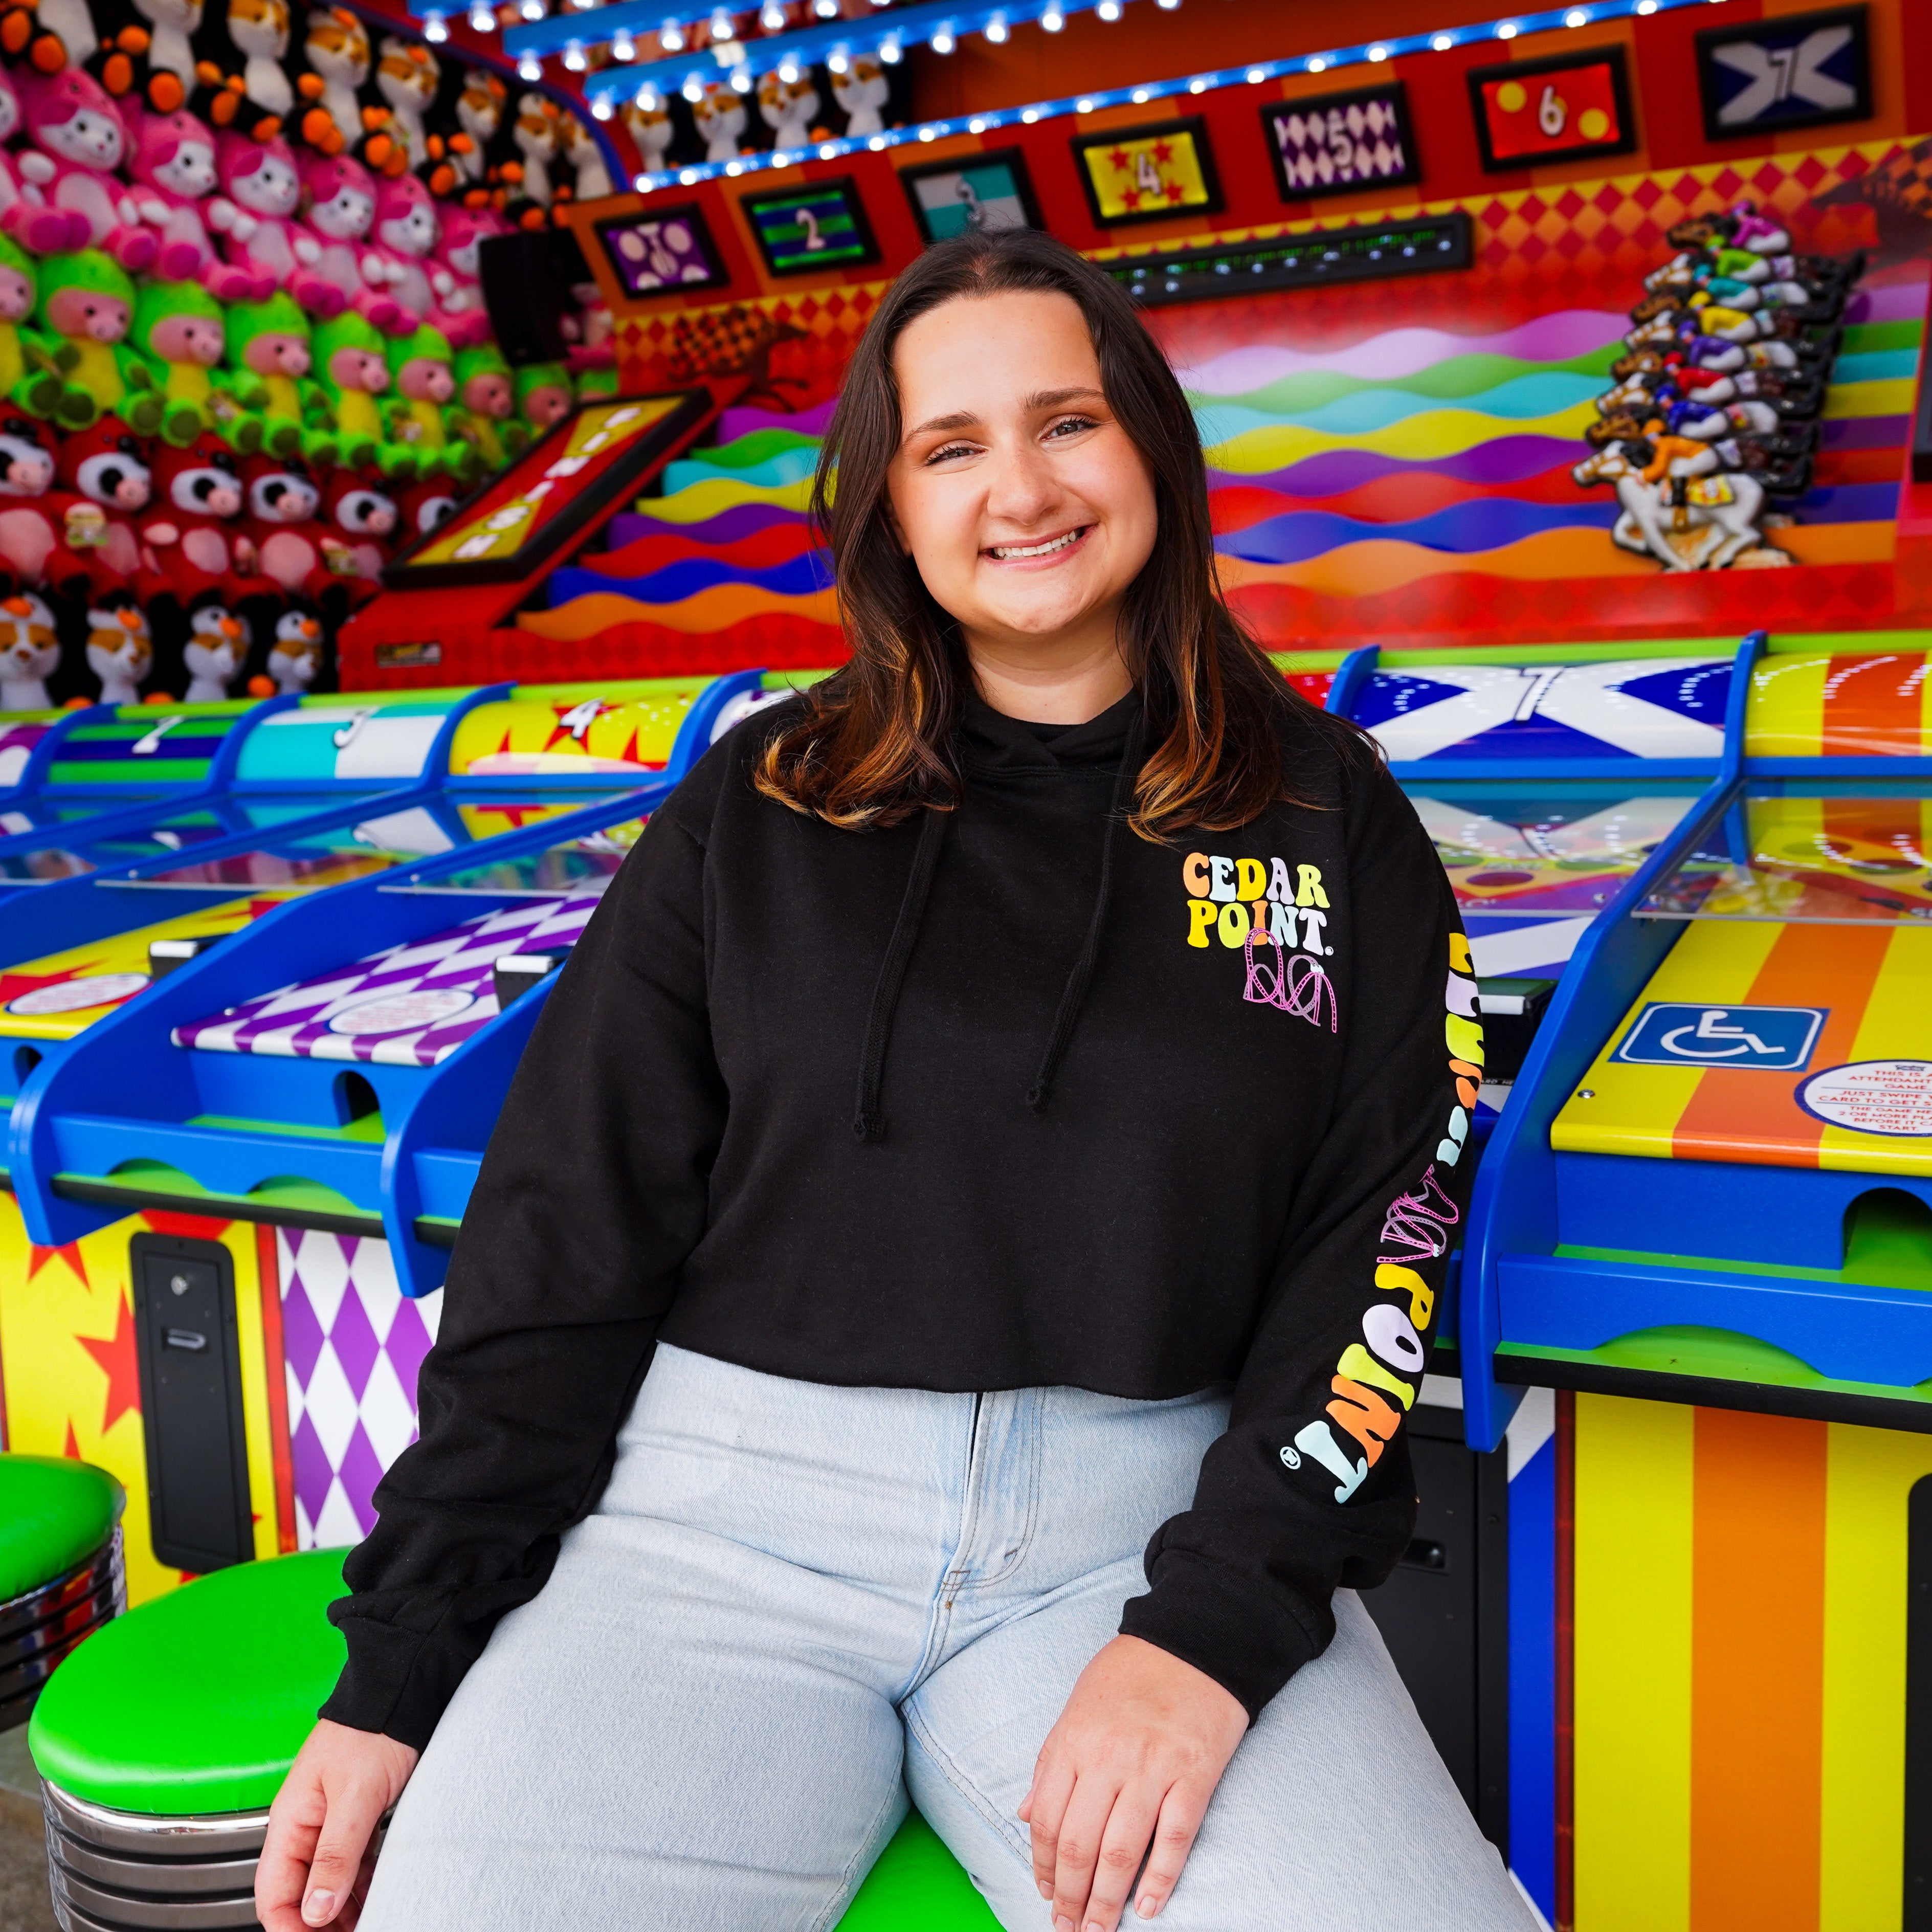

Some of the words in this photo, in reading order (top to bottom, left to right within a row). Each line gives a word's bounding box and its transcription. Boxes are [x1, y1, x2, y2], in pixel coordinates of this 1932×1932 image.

[1767, 49, 1799, 100] 7
[1538, 84, 1566, 137] 6
[1328, 118, 1353, 167] 5
[1137, 153, 1162, 195] 4
[794, 207, 826, 250] 2
[559, 697, 607, 740] 4
[1513, 667, 1564, 723] 7
[1183, 852, 1330, 908] CEDAR
